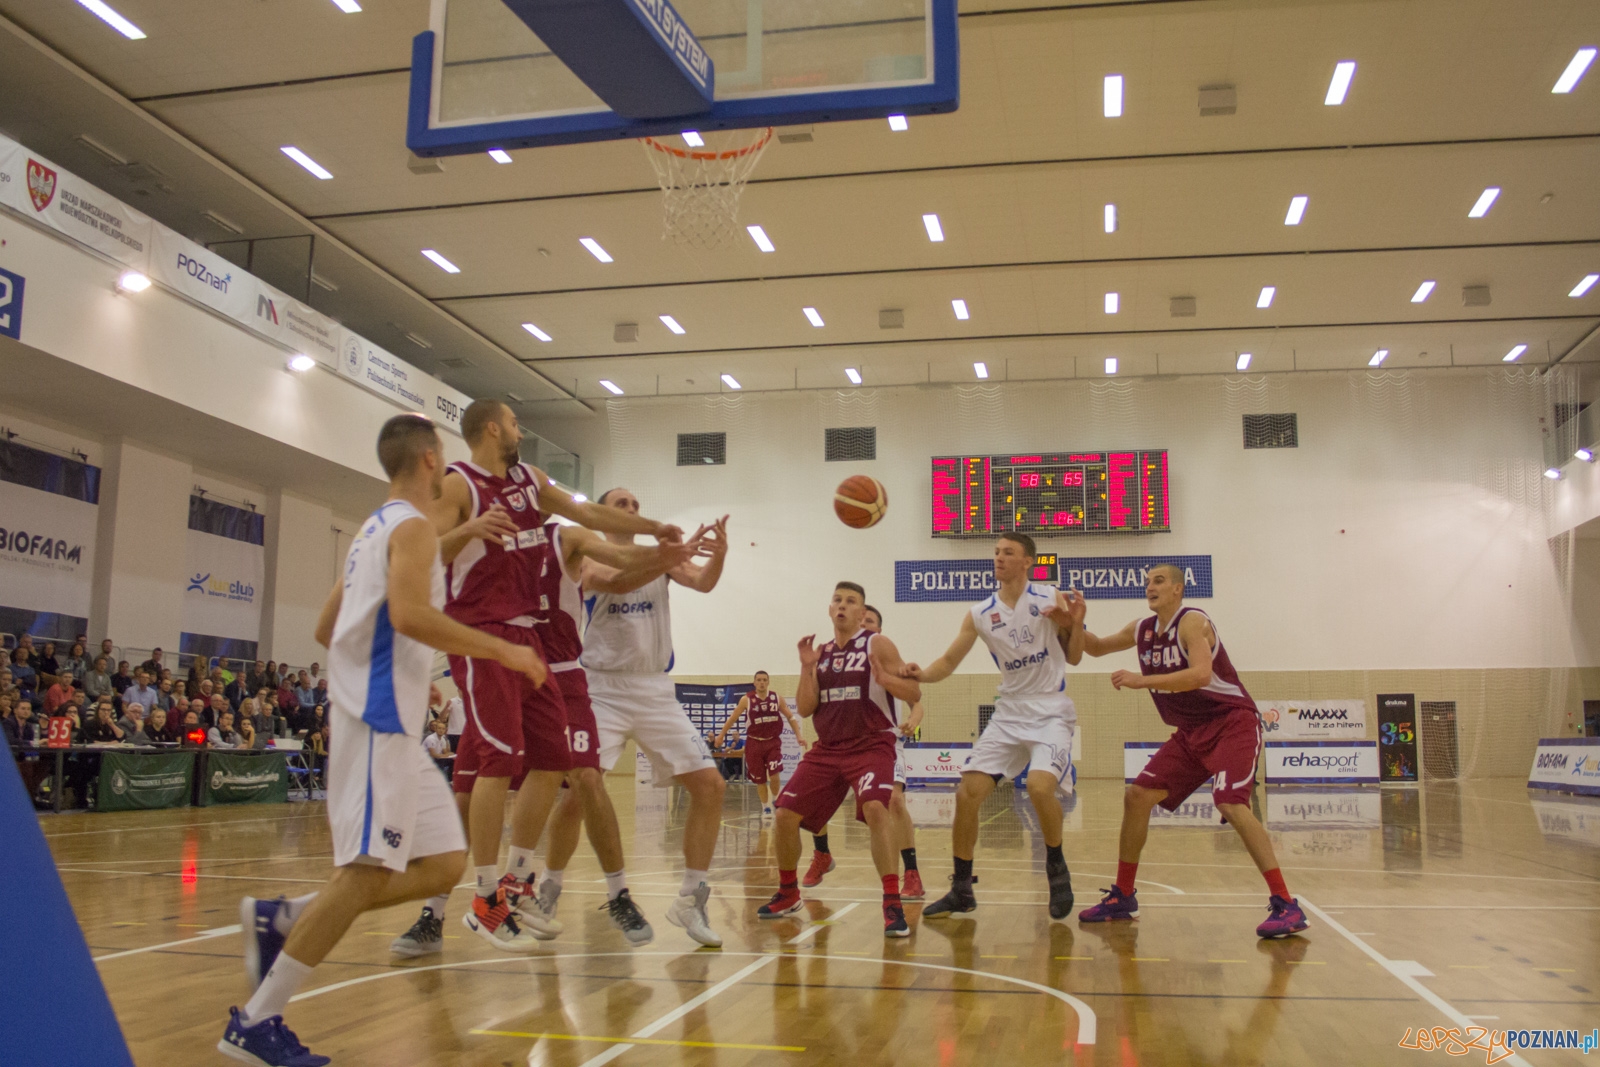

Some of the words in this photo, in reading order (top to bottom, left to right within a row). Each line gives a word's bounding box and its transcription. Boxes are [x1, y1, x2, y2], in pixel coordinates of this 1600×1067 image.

[662, 6, 709, 79] SYSTEM
[1020, 473, 1039, 488] 58
[1063, 471, 1083, 487] 65
[1037, 556, 1055, 565] 18.6
[1069, 564, 1197, 589] POZNAŃA
[1009, 625, 1035, 648] 14
[844, 651, 867, 672] 22
[1163, 645, 1181, 668] 44
[1298, 708, 1348, 720] MAXXX
[1308, 721, 1320, 729] hit
[1336, 721, 1364, 729] hitem
[564, 725, 590, 753] 18
[1282, 752, 1359, 770] rehasport
